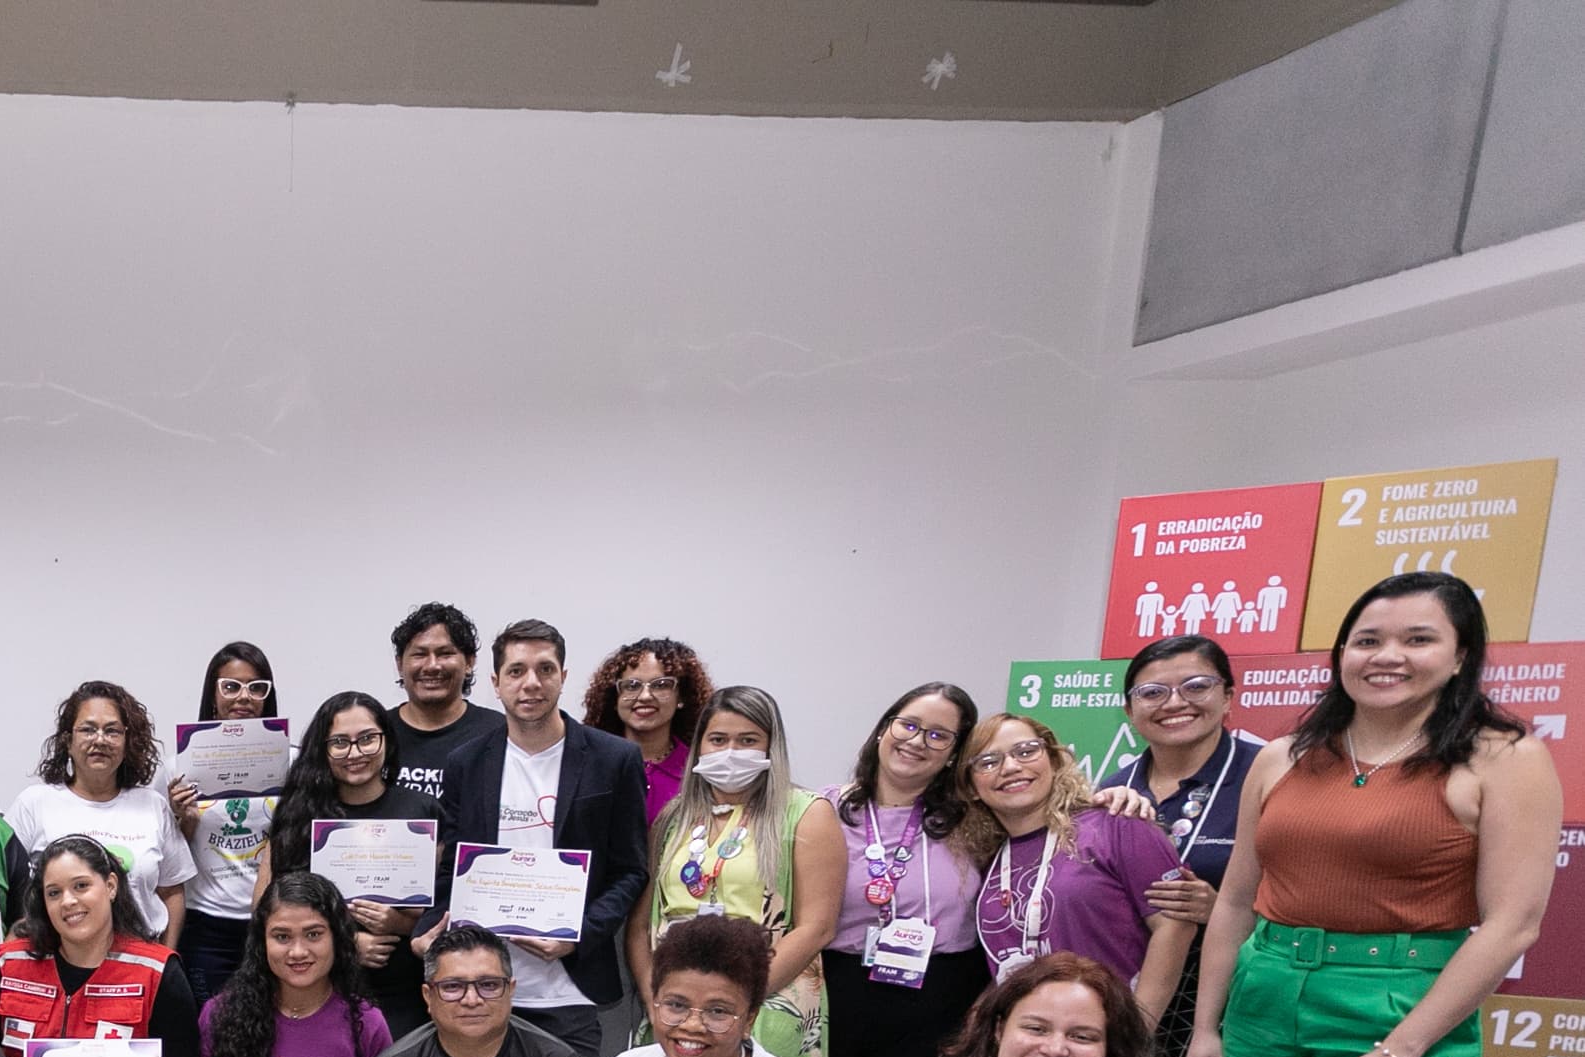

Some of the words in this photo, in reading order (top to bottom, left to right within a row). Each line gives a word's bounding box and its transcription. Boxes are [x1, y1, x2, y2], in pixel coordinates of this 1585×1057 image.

[1381, 481, 1429, 502] FOME
[1433, 479, 1479, 498] ZERO
[1337, 487, 1367, 527] 2
[1378, 507, 1391, 524] E
[1392, 498, 1518, 523] AGRICULTURA
[1158, 511, 1263, 536] ERRADICAÇÃO
[1374, 521, 1491, 546] SUSTENTÁVEL
[1131, 523, 1147, 557] 1
[1155, 540, 1176, 556] DA
[1179, 535, 1247, 554] POBREZA
[1054, 670, 1101, 688] SAÚDE
[1103, 673, 1114, 688] E
[1242, 664, 1332, 689] EDUCAÇÃO
[1018, 674, 1042, 708] 3
[1487, 682, 1561, 704] GÊNERO
[894, 929, 924, 941] Aurora
[1490, 1008, 1543, 1049] 12
